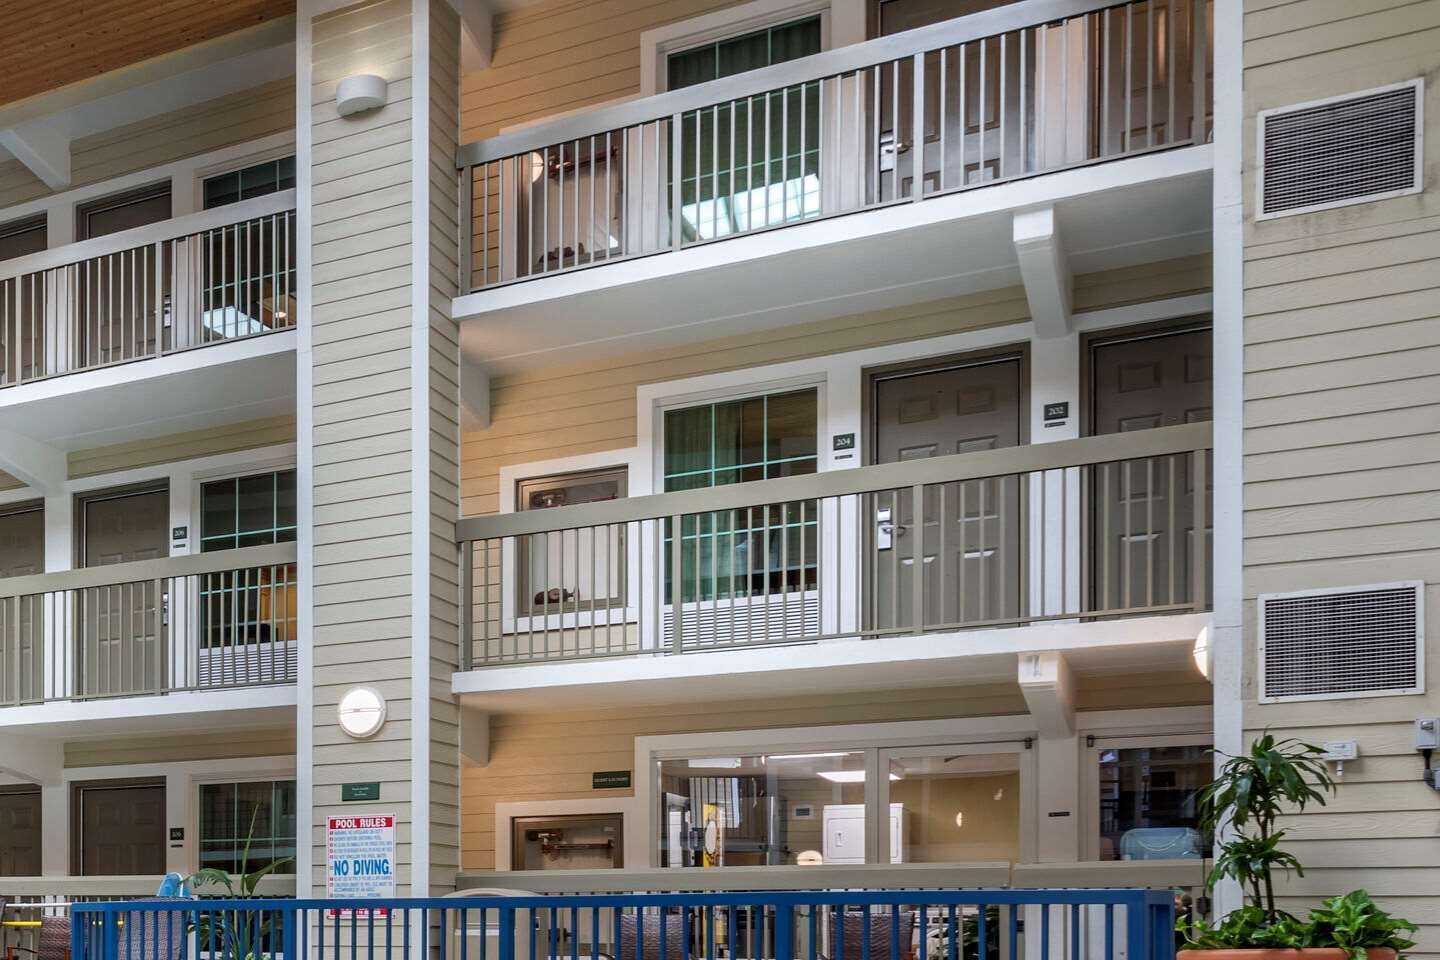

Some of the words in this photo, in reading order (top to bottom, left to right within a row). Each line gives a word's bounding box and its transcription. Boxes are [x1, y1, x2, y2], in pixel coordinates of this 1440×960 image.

[335, 819, 358, 829] POOL
[360, 817, 386, 828] RULES
[334, 860, 349, 876] NO
[353, 859, 392, 876] DIVING.
